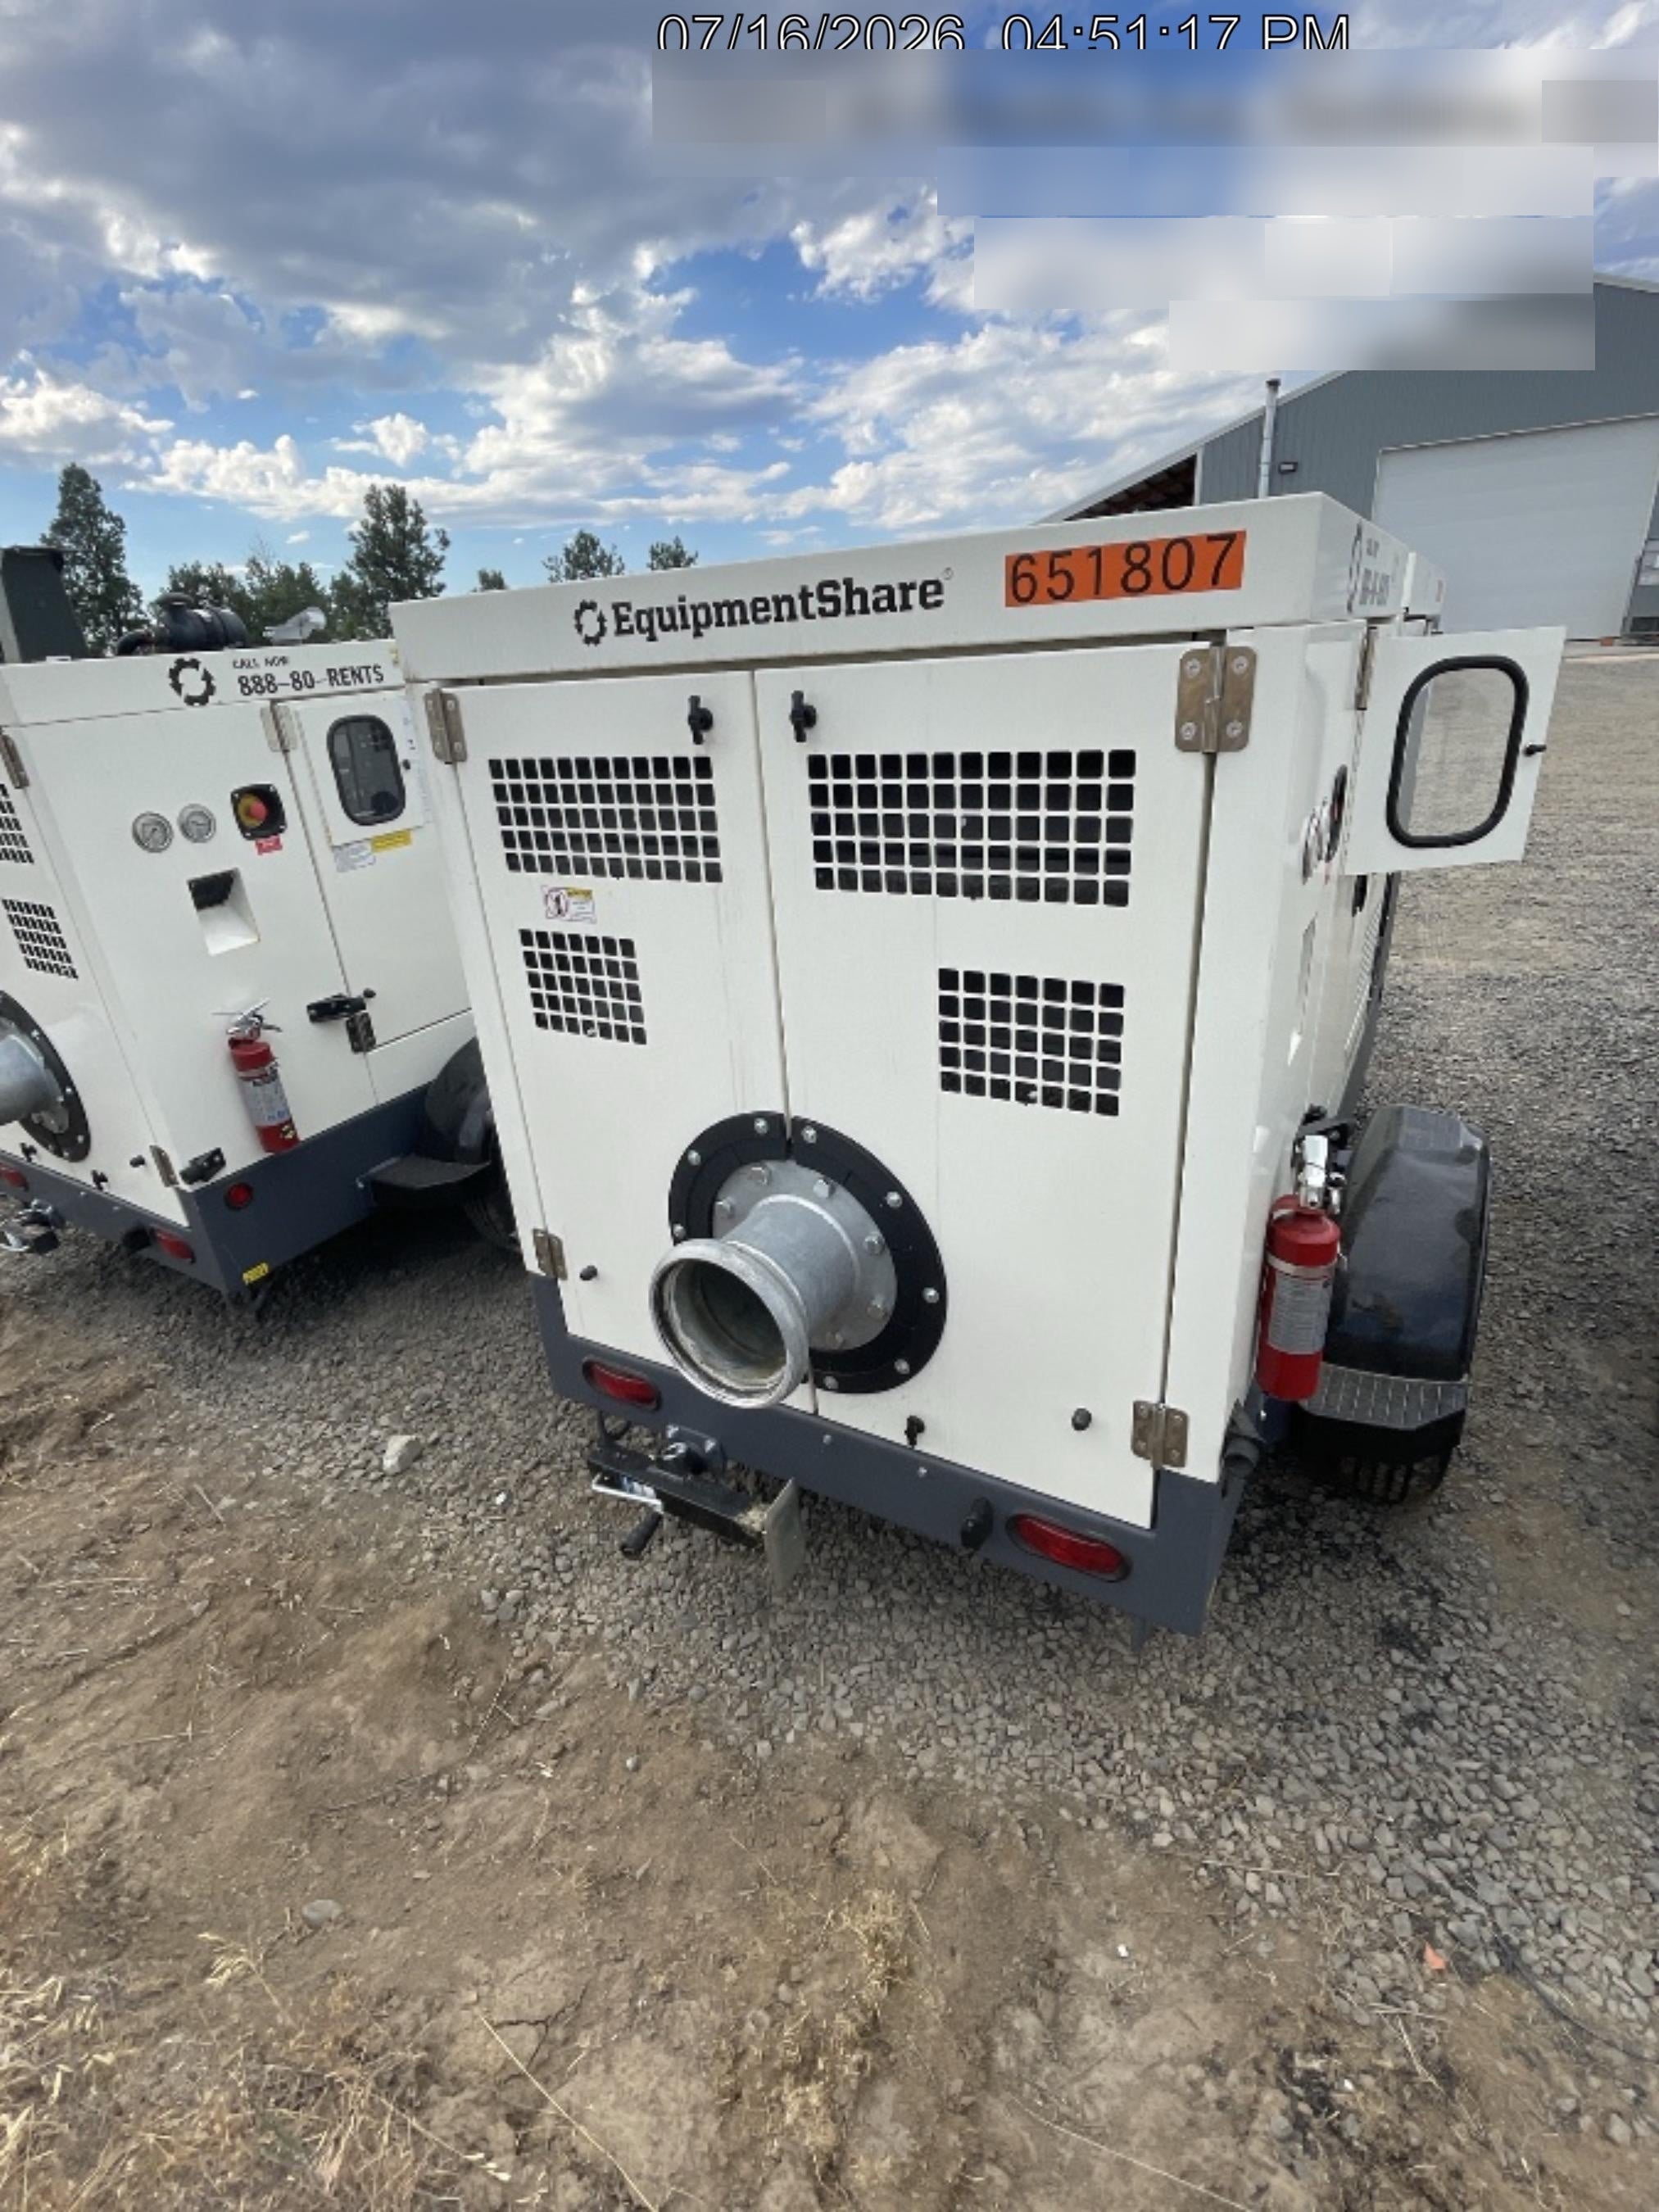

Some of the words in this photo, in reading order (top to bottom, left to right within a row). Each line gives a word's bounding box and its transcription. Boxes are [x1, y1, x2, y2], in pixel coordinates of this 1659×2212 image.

[1011, 533, 1237, 604] 651807
[610, 577, 945, 642] EquipmentShare
[238, 664, 384, 696] 888-80-RENTS
